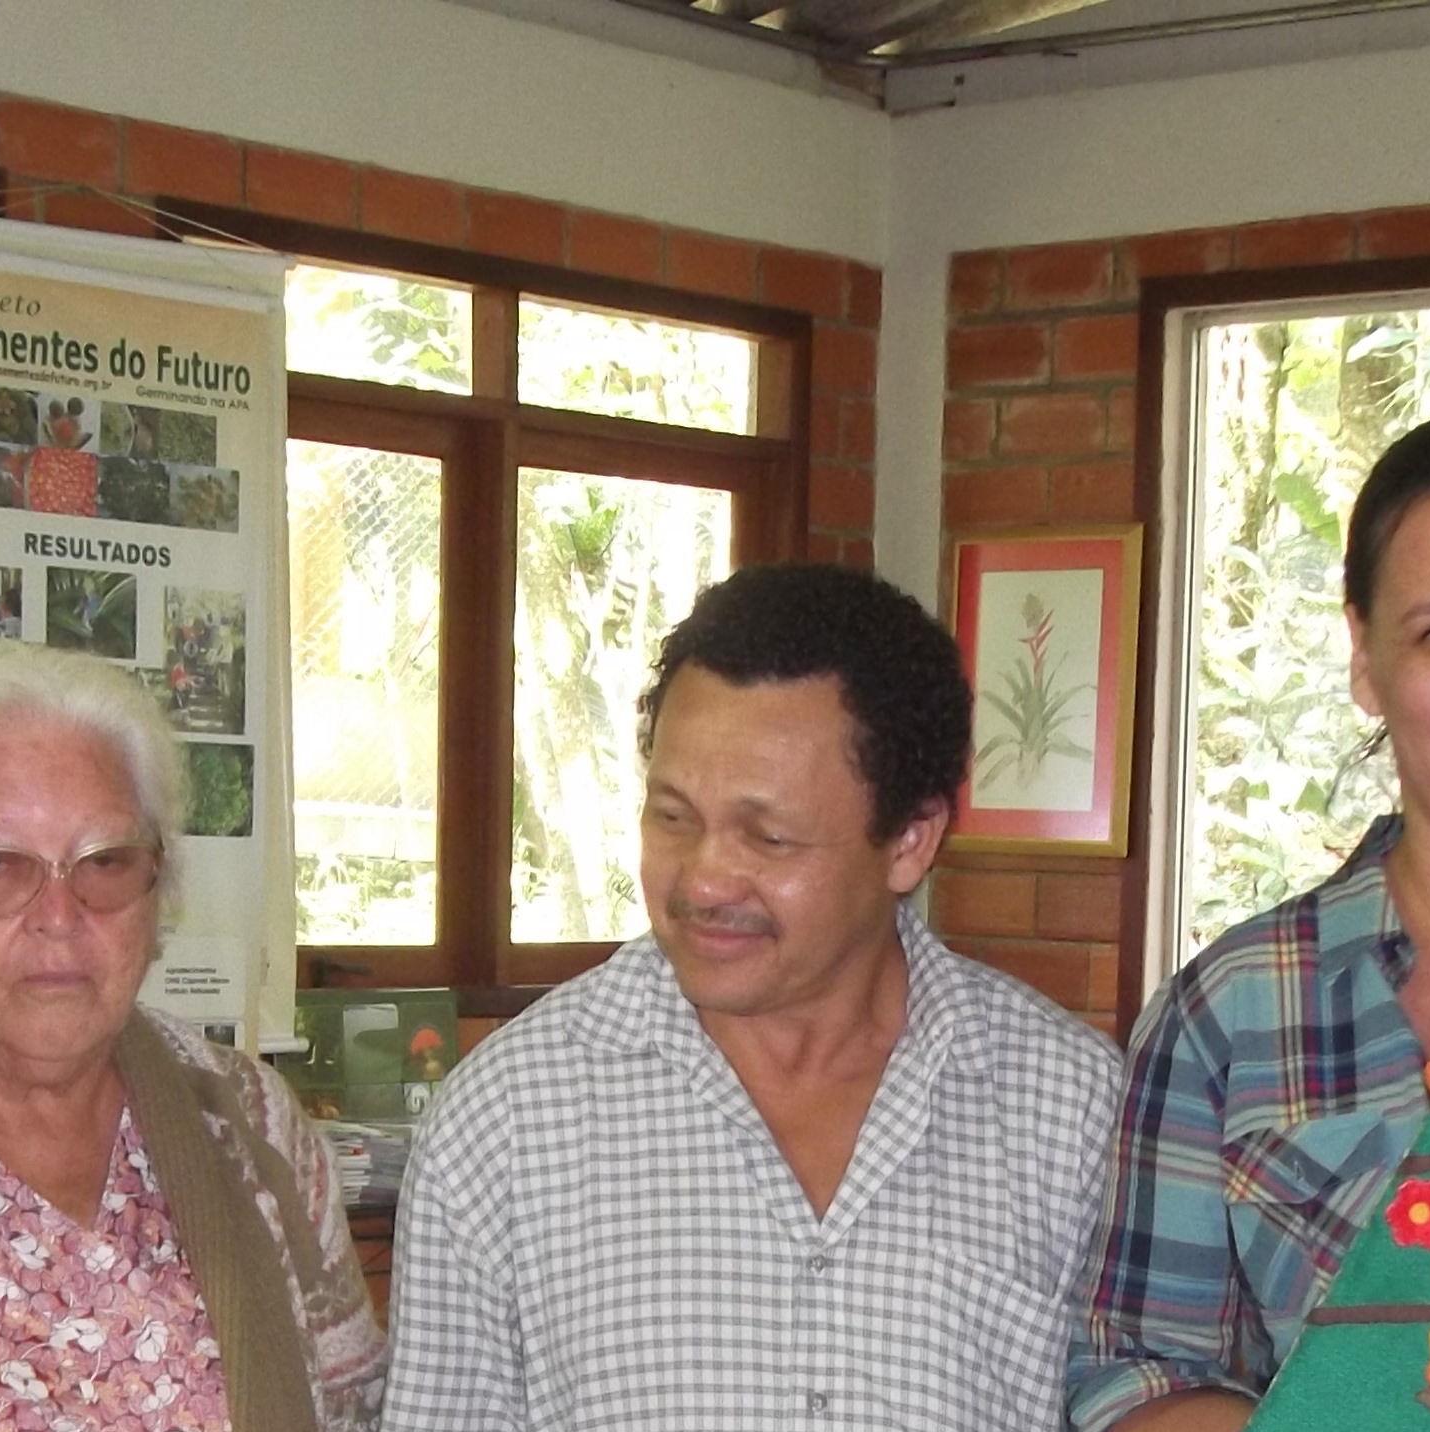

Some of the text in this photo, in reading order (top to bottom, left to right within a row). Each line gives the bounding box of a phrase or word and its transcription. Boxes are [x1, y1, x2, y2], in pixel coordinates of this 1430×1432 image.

[109, 337, 146, 381] do
[157, 344, 252, 396] Futuro
[135, 384, 251, 412] Germinando na APA
[23, 531, 173, 569] RESULTADOS
